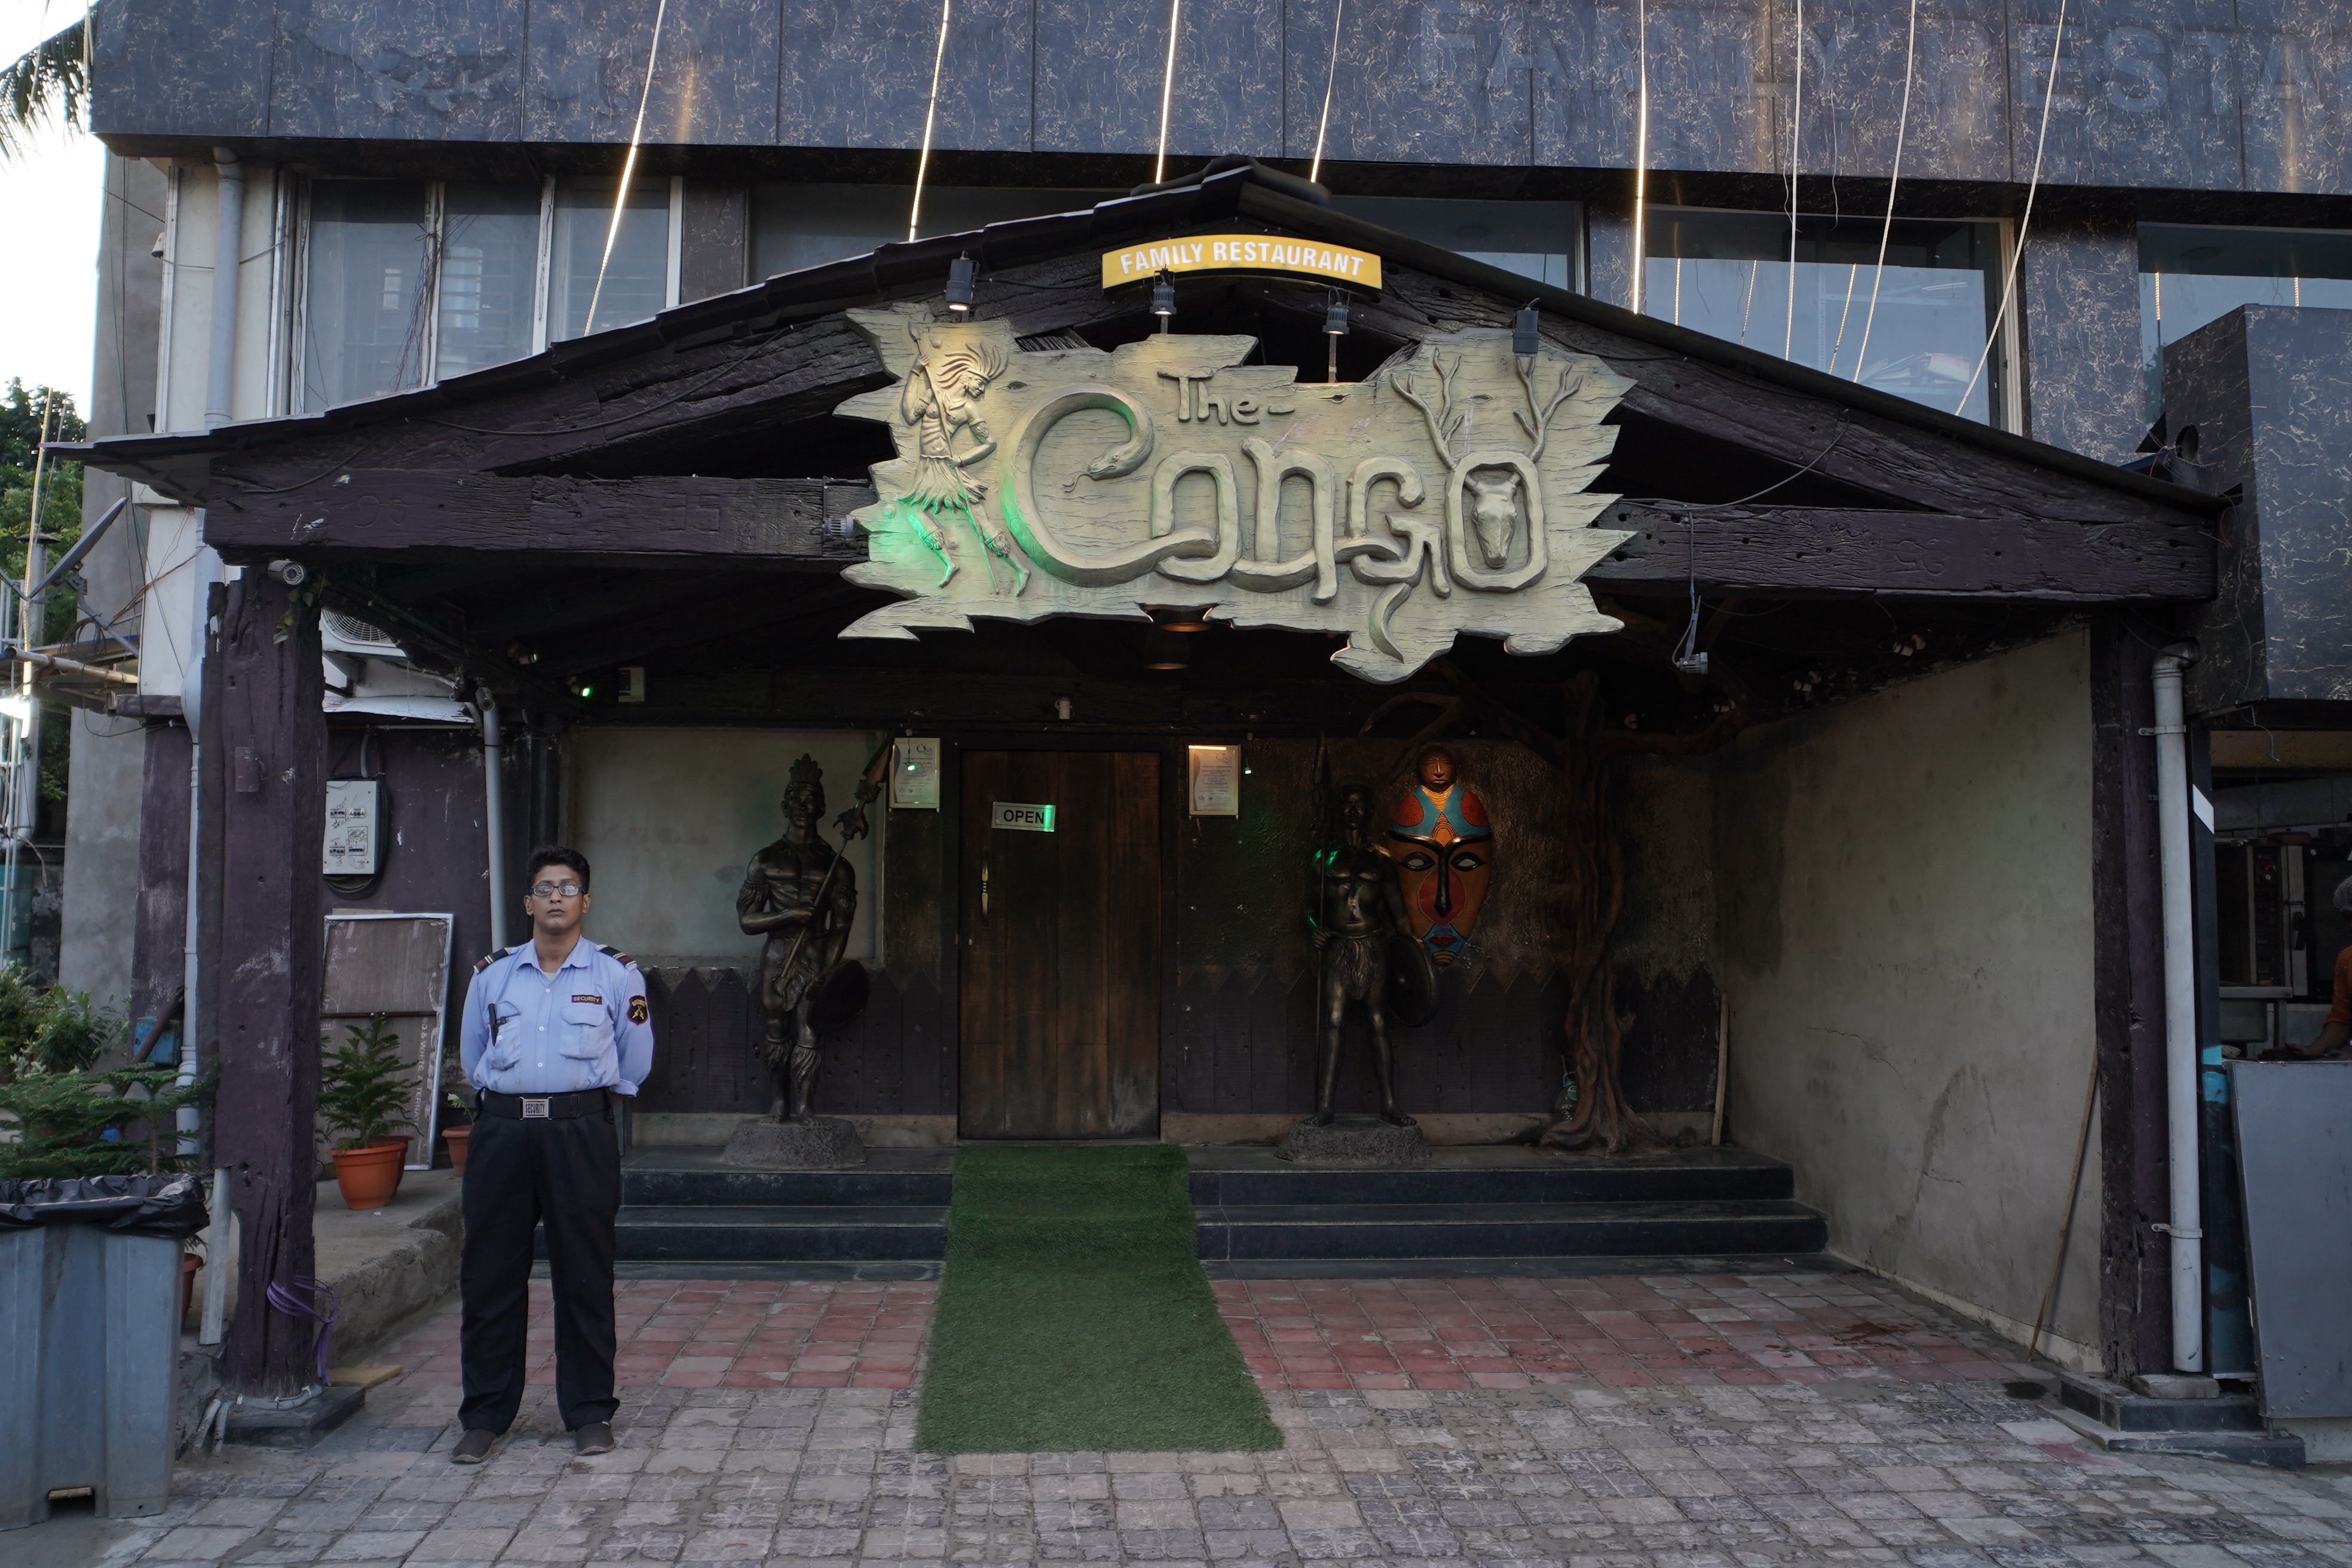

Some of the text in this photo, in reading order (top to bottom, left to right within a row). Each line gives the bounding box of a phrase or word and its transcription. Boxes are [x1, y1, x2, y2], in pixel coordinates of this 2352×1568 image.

[1119, 241, 1365, 277] FAMILY RESTAURANT
[1003, 808, 1045, 825] OPEN
[525, 1103, 545, 1114] SECURITY
